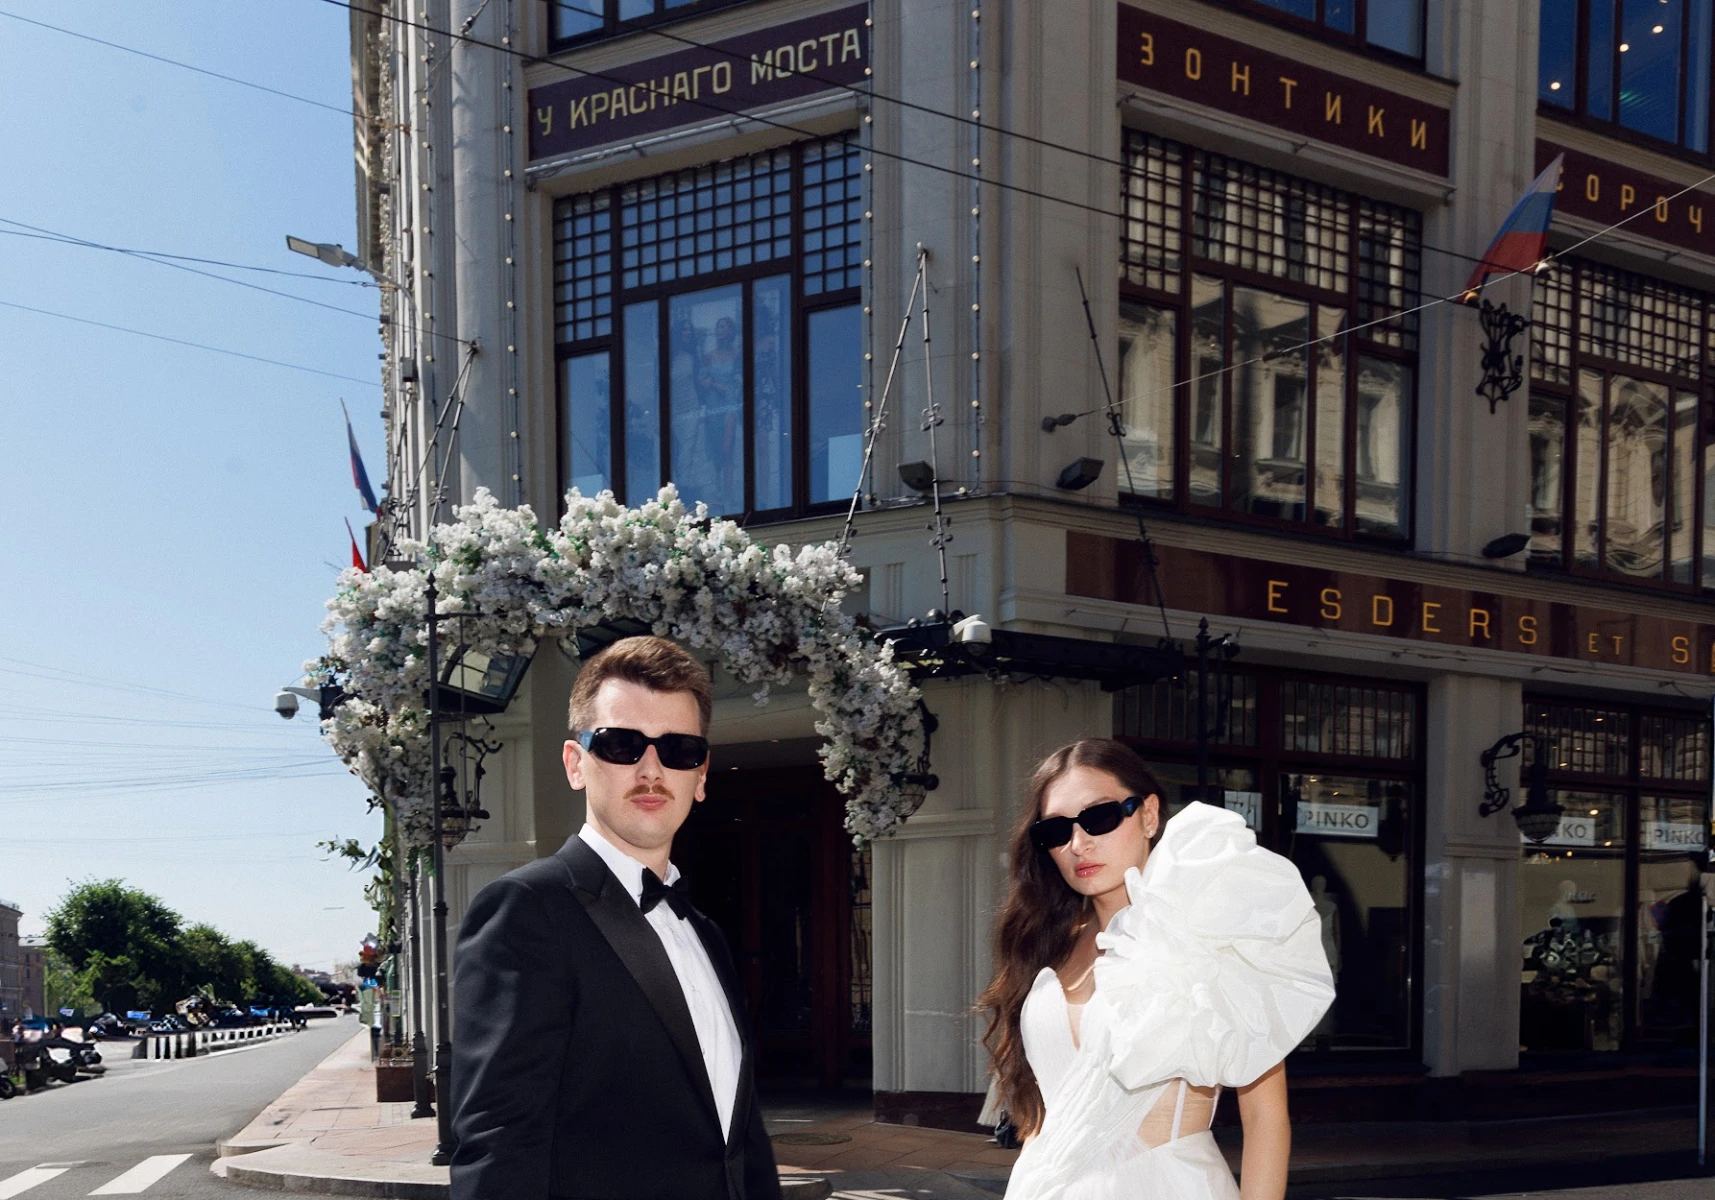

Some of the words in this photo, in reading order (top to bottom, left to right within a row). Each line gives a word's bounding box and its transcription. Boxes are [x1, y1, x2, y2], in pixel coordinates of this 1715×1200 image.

[537, 105, 552, 136] У
[570, 61, 732, 129] КРАСНАГО
[751, 28, 861, 85] МОСТА
[1140, 33, 1427, 150] ЗОНТИКИ
[1268, 580, 1538, 645] ESDERS
[1588, 632, 1623, 655] ET
